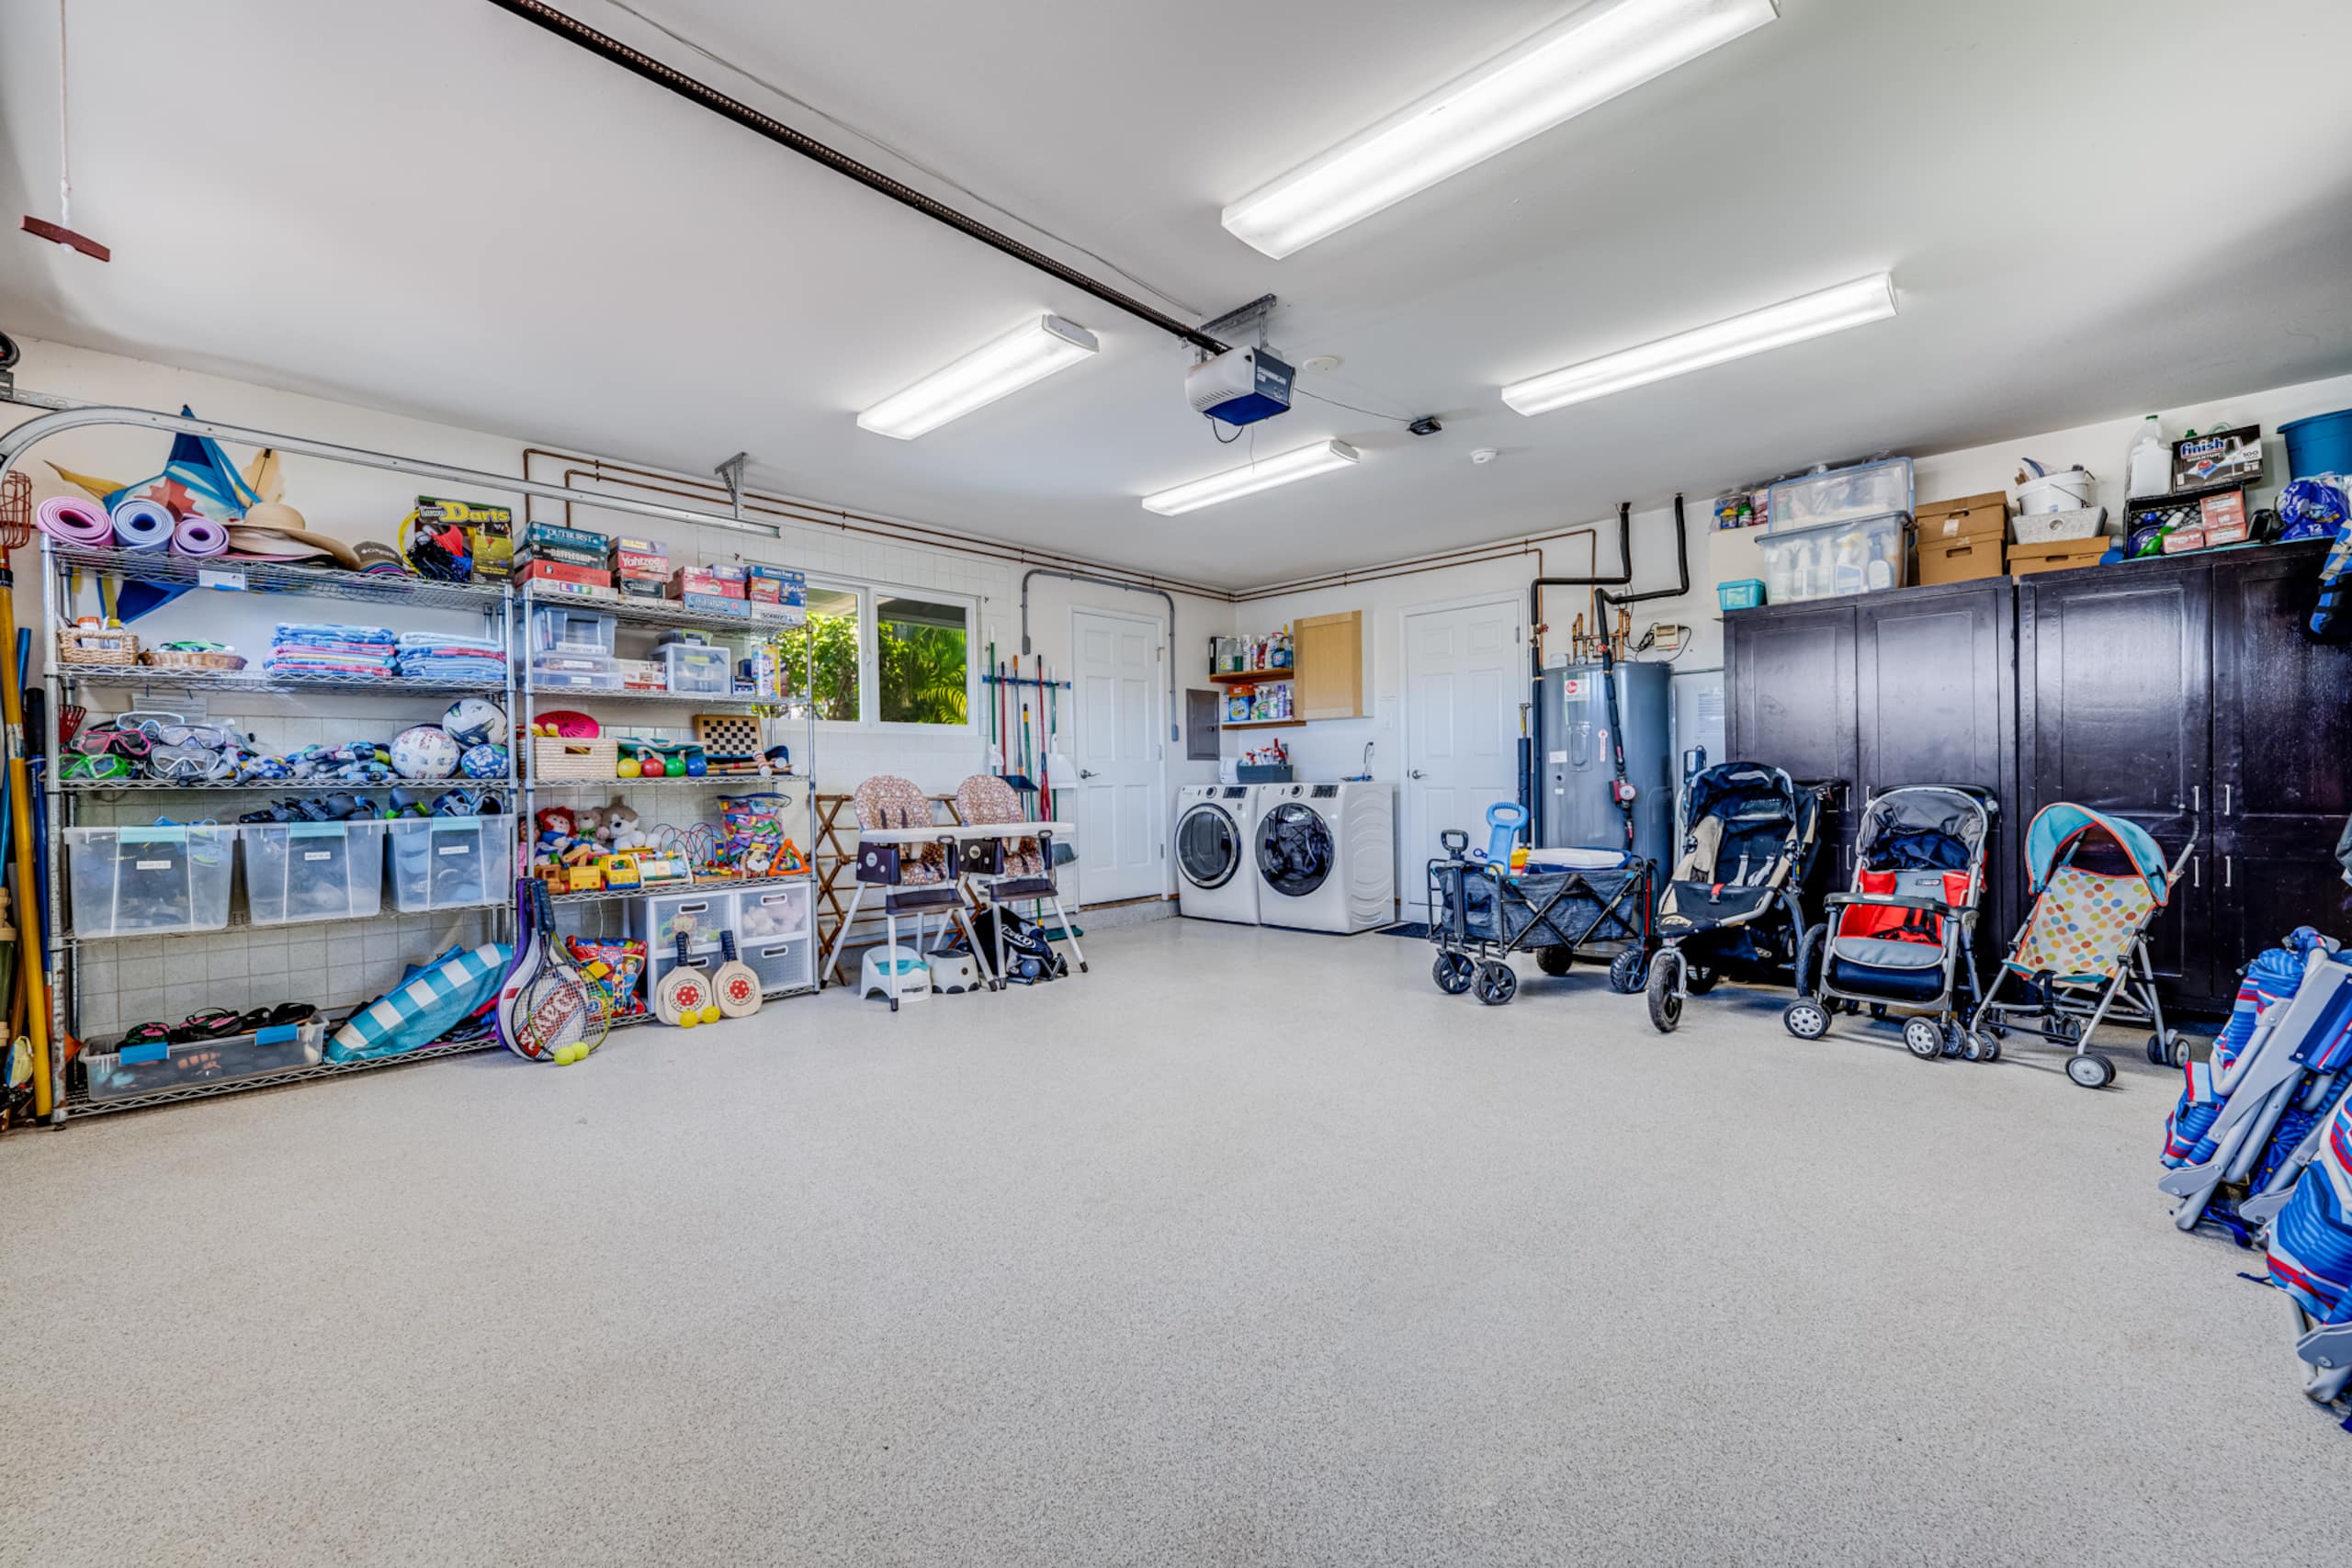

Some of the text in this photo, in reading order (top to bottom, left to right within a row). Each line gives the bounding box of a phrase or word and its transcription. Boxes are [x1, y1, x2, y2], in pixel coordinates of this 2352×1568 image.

[2180, 437, 2224, 457] finish
[435, 501, 511, 522] Darts
[622, 556, 661, 567] Yahtzee
